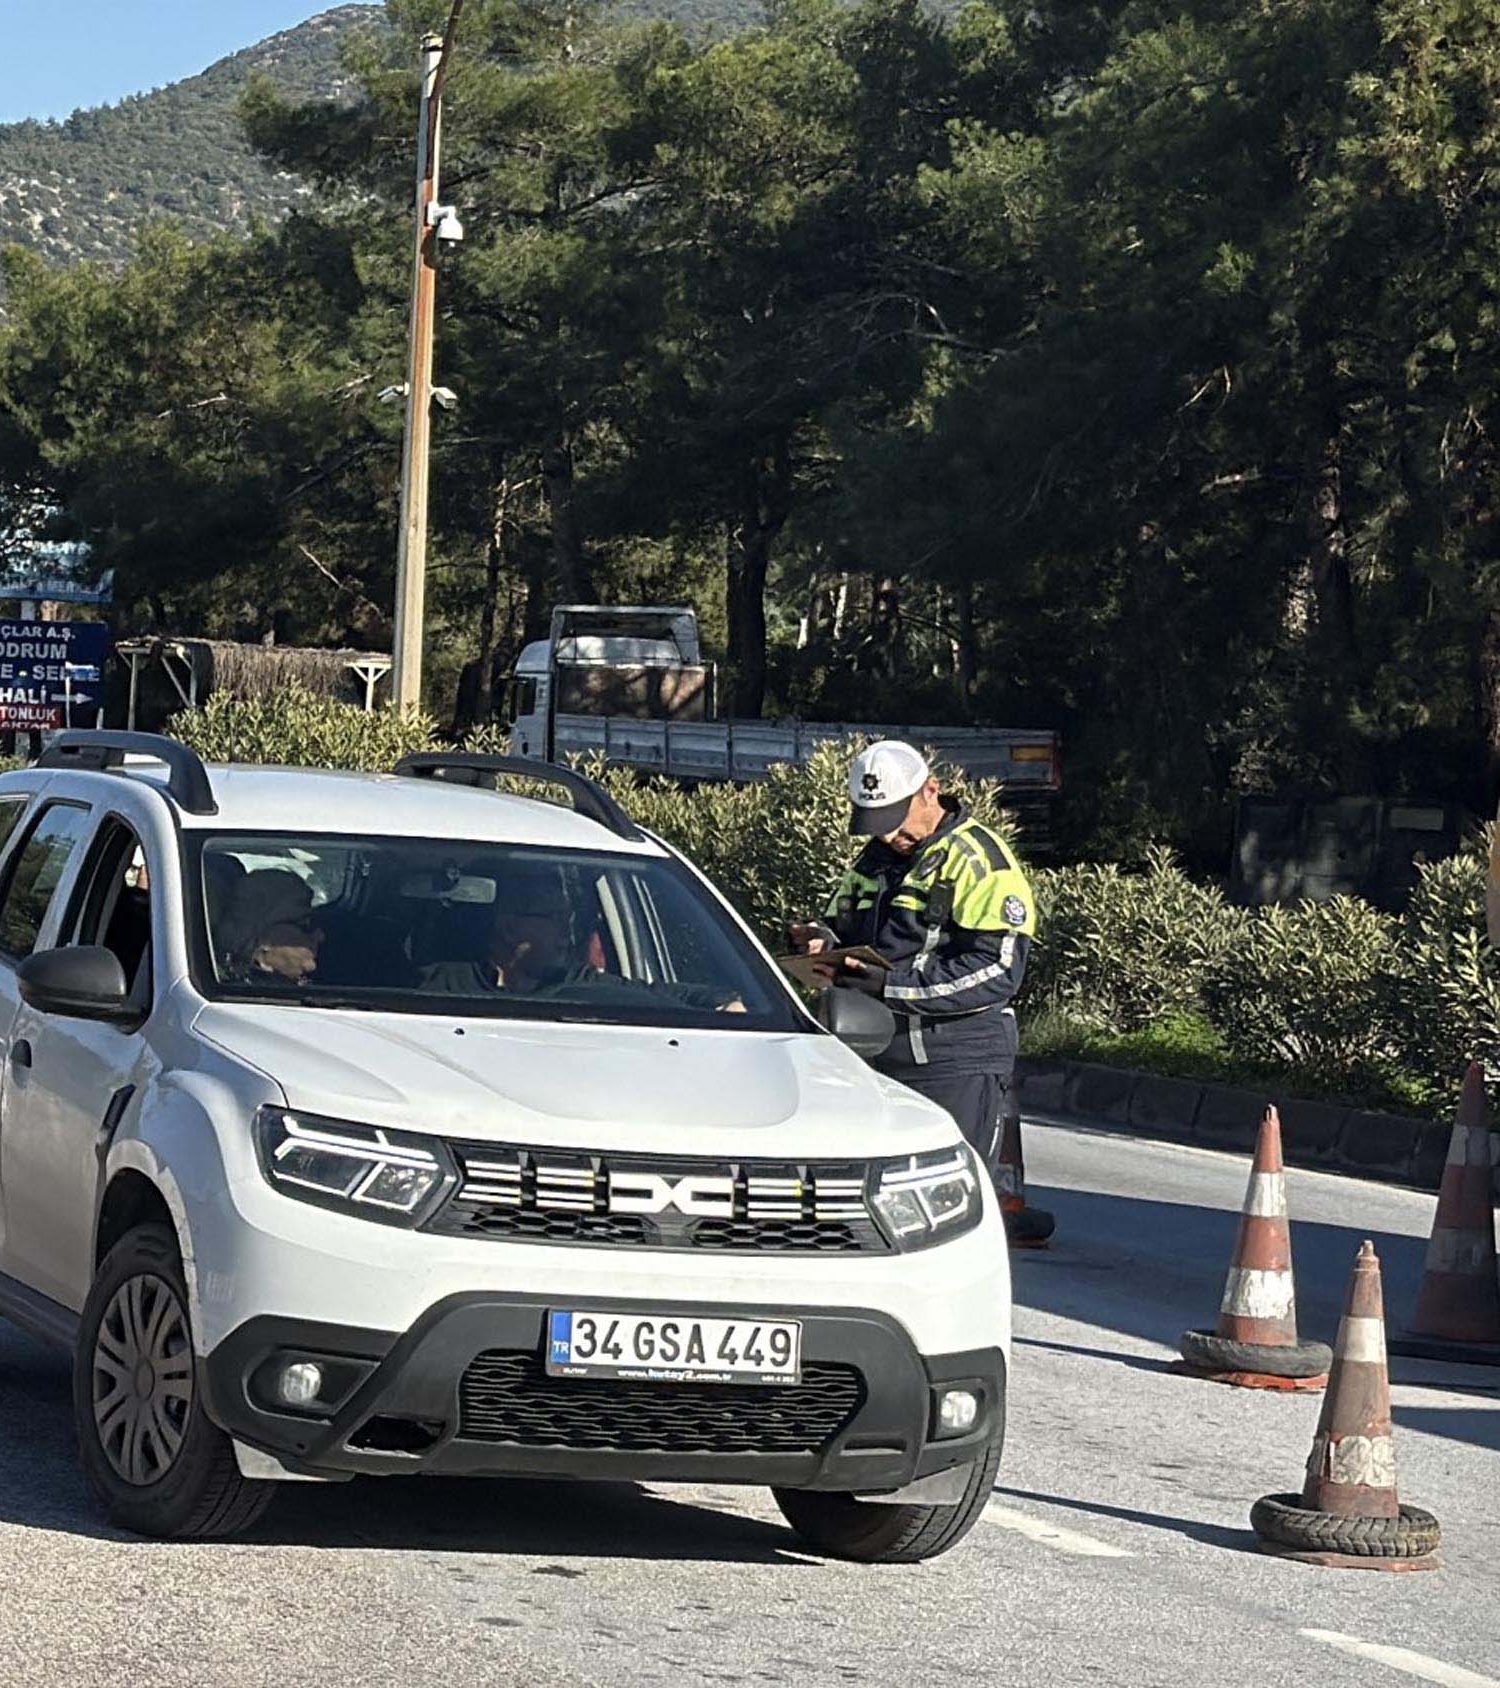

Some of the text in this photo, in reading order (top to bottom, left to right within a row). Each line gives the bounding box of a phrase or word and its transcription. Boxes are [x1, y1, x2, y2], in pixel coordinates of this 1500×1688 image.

[46, 626, 76, 641] A.Ş.
[0, 706, 56, 722] TONLUK
[552, 1340, 570, 1354] TR
[574, 1318, 792, 1368] 34 GSA 449
